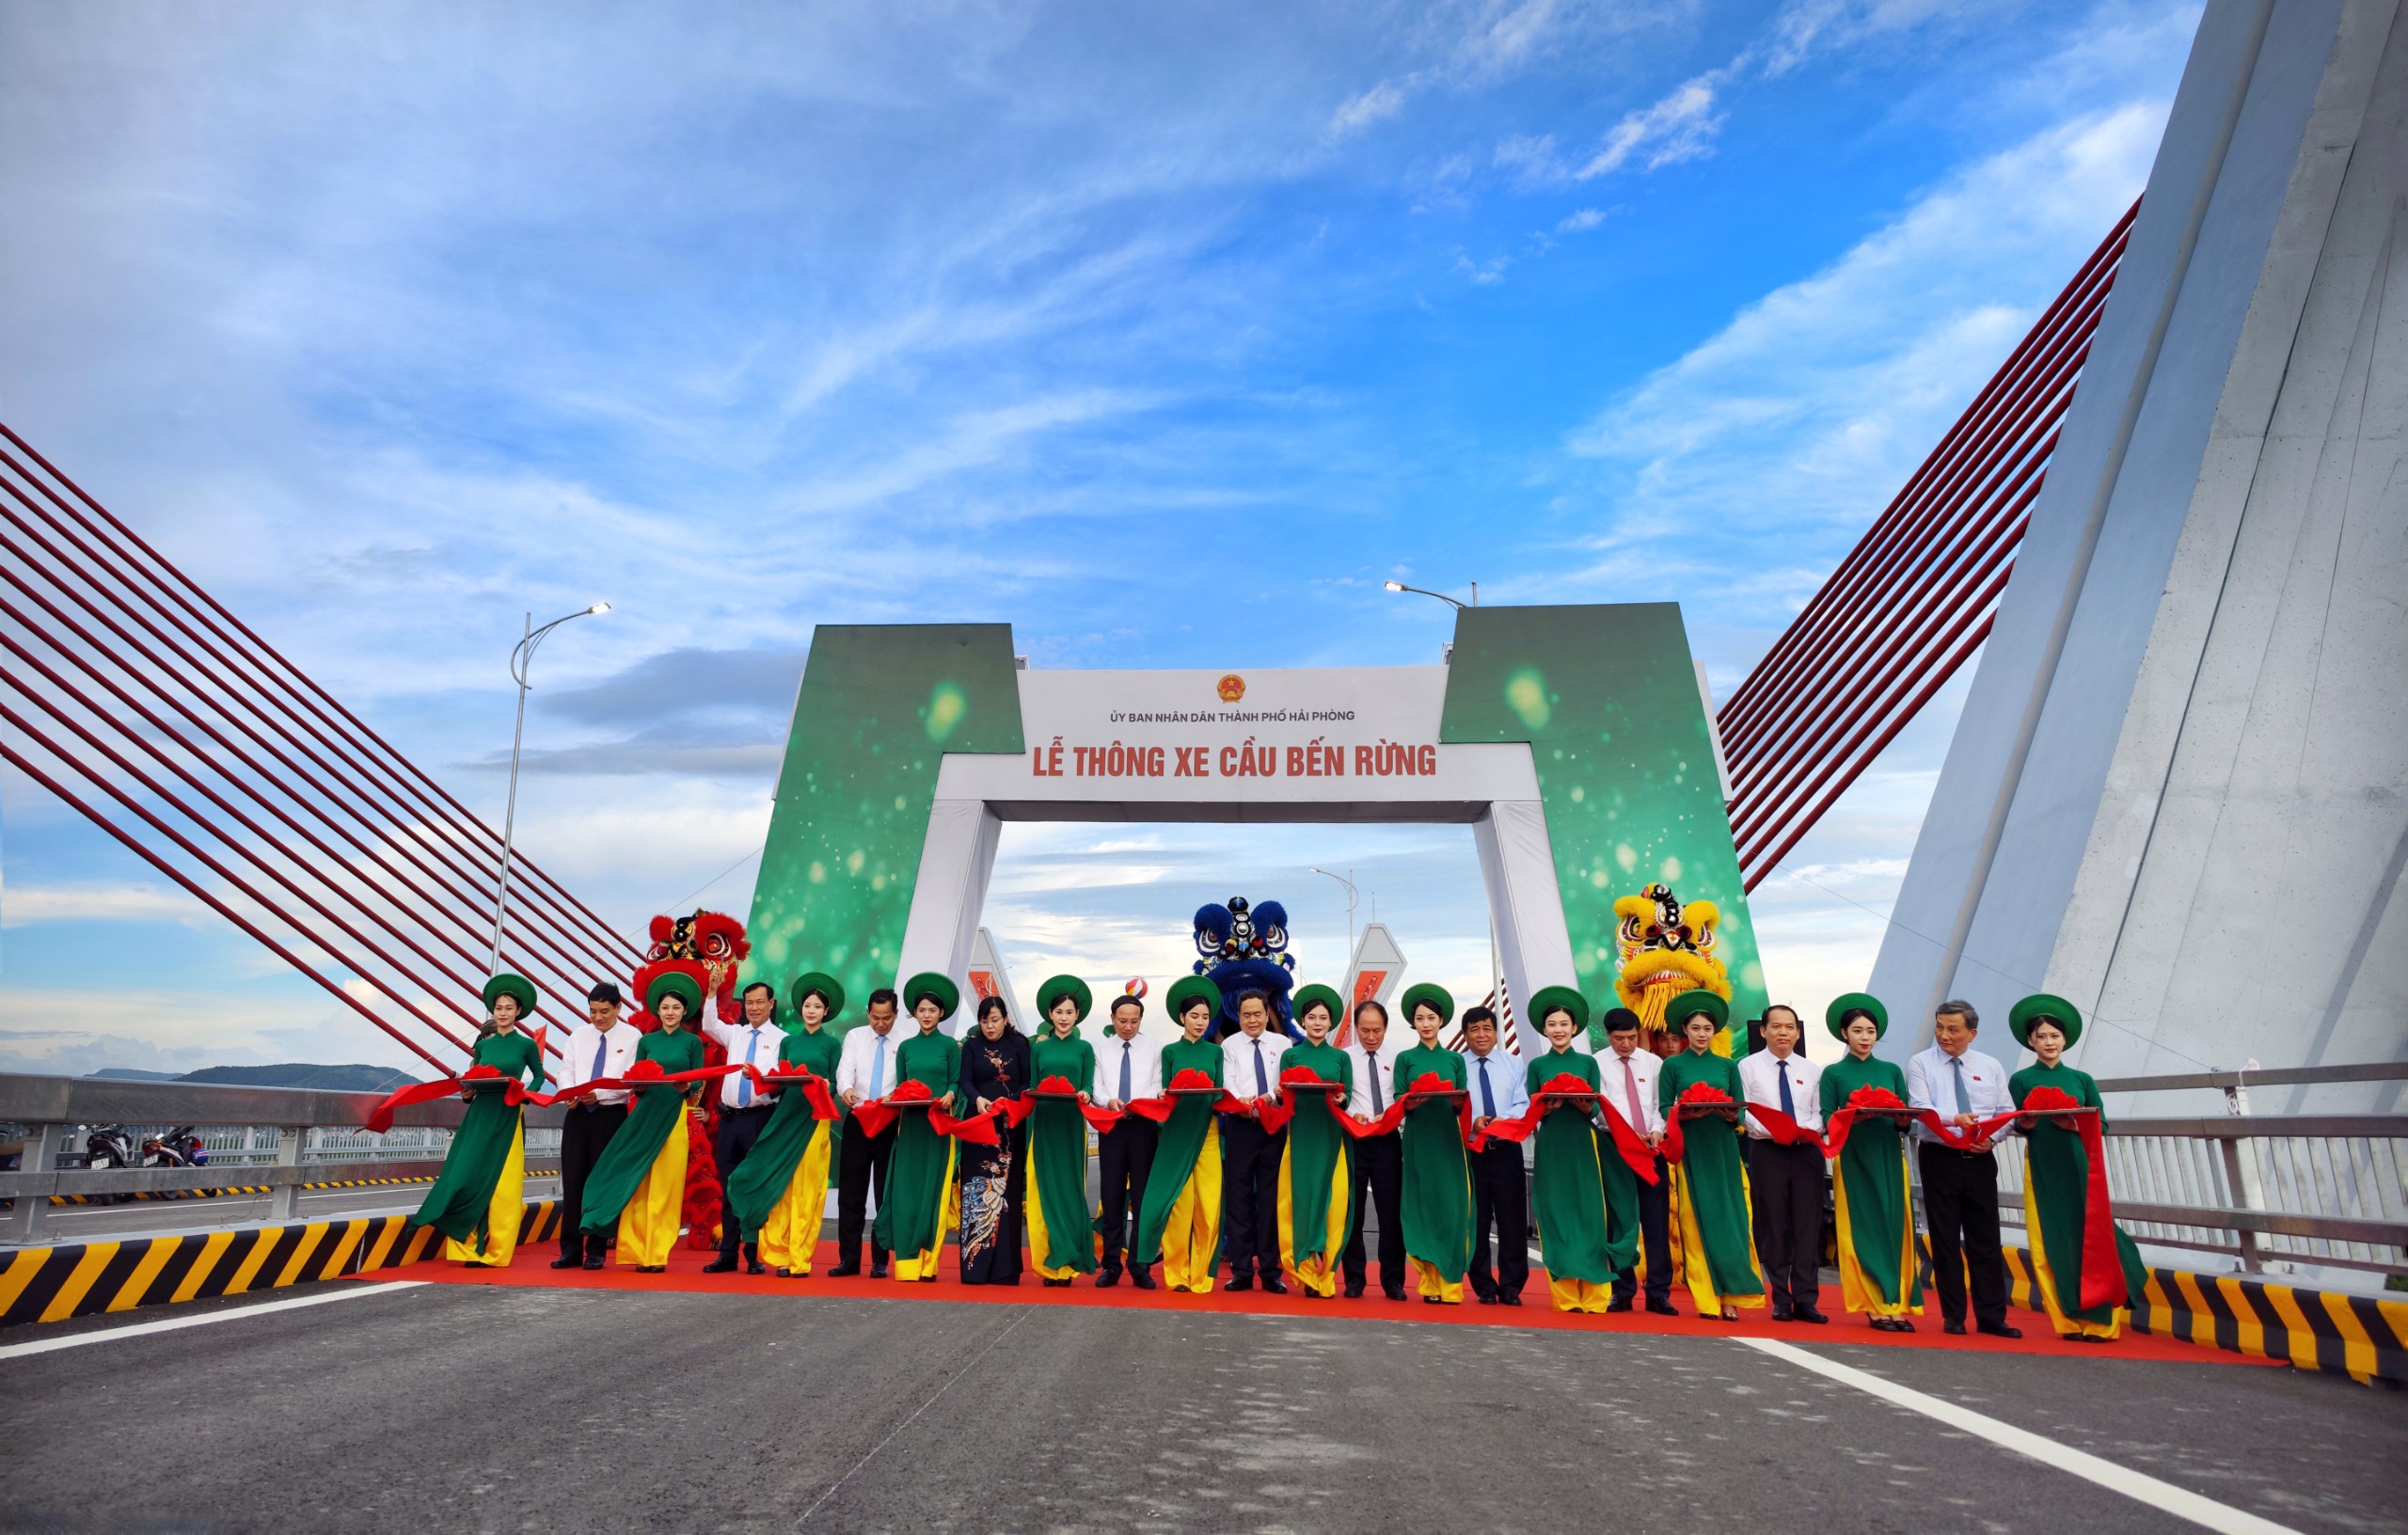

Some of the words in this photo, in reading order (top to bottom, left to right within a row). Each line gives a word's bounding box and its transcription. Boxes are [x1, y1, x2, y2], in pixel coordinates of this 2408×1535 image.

[1111, 709, 1127, 723] ỦY
[1129, 713, 1153, 723] BAN
[1155, 710, 1188, 723] NHÂN
[1191, 710, 1216, 723] DÂN
[1218, 709, 1259, 722] THÀNH
[1261, 707, 1287, 722] PHỐ
[1289, 708, 1309, 722] HẢI
[1312, 708, 1355, 721] PHÒNG
[1034, 736, 1064, 777] LỄ
[1074, 740, 1164, 777] THÔNG
[1174, 747, 1209, 777] XE
[1220, 736, 1276, 777] CẦU
[1287, 736, 1344, 776] BẾN
[1355, 738, 1436, 776] RỪNG
